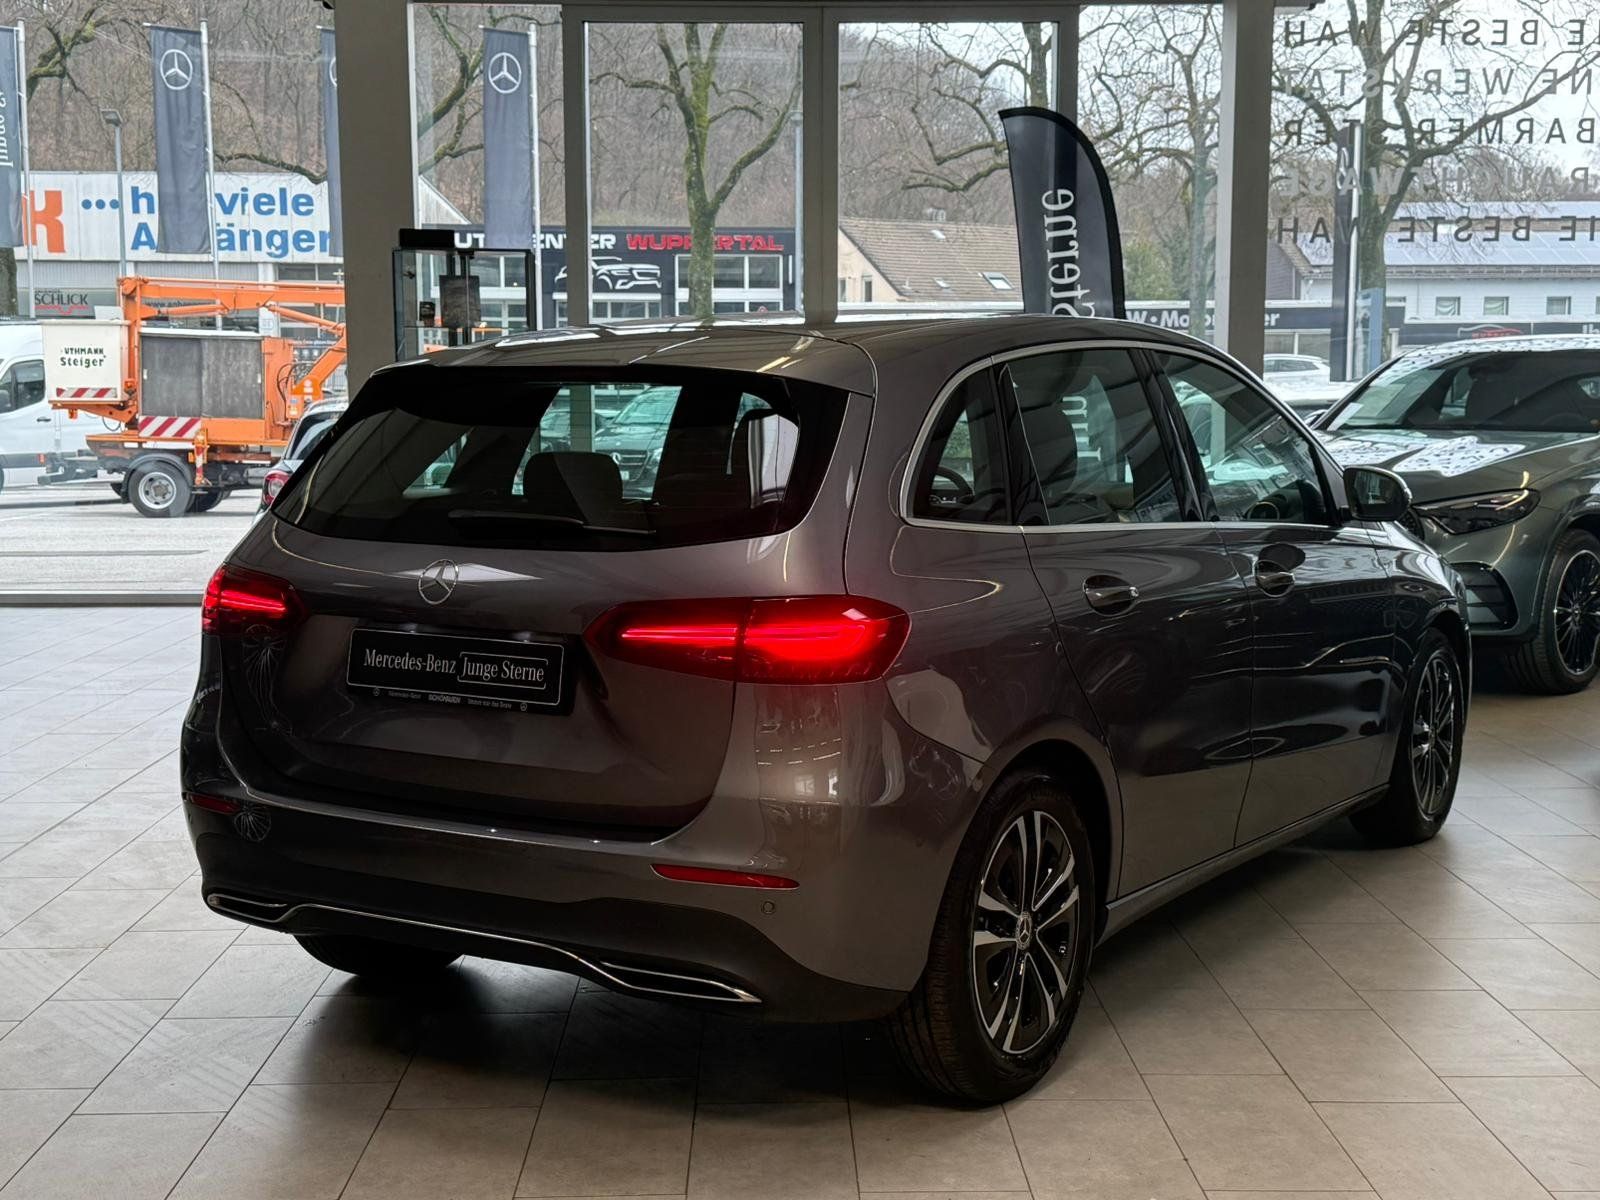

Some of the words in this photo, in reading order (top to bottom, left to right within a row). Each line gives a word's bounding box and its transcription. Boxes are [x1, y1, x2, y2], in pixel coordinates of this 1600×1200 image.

[215, 187, 314, 216] viele
[131, 222, 331, 258] Aänger
[60, 356, 104, 369] Steiger
[363, 648, 456, 674] Mercedes-Benz
[461, 657, 498, 681] Junge
[500, 660, 545, 682] Sterne
